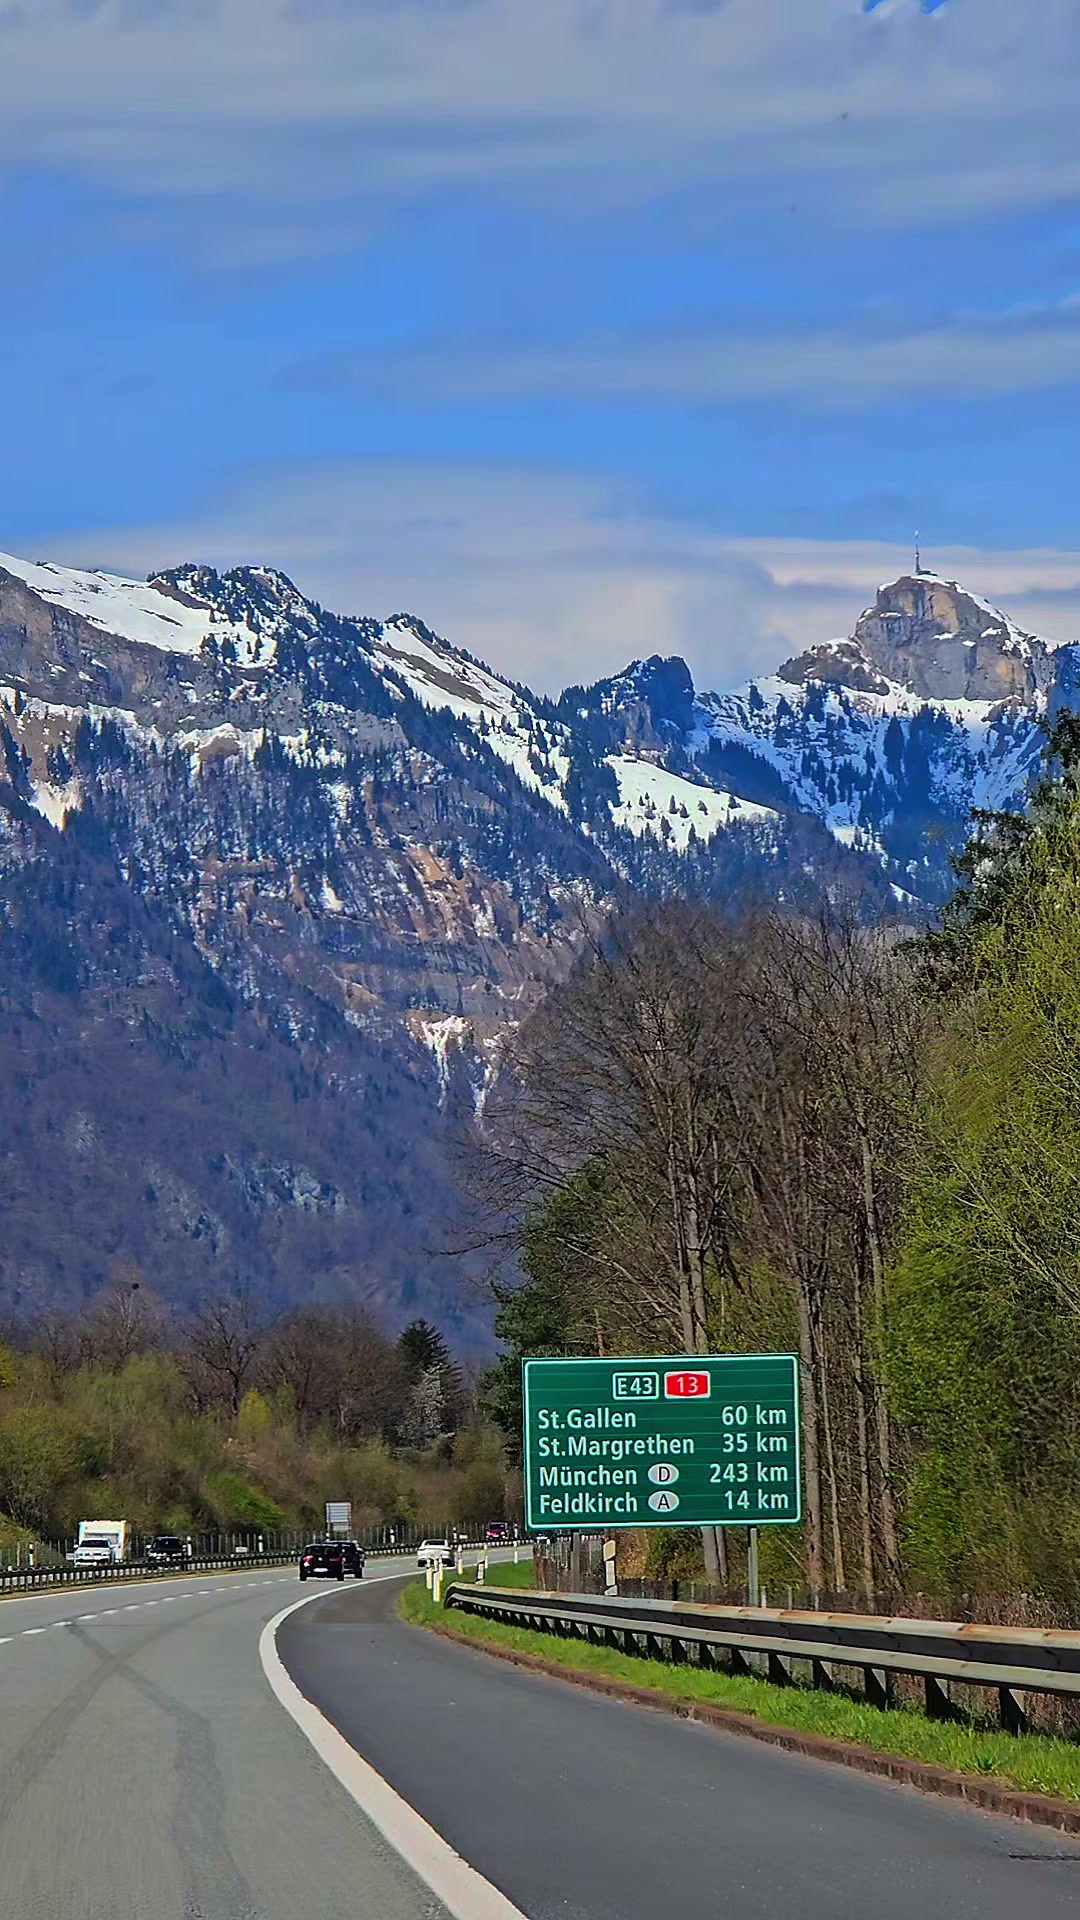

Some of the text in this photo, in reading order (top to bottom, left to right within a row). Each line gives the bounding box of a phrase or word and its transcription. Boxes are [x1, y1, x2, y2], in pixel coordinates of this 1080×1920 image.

[617, 1377, 652, 1395] E43
[677, 1377, 698, 1393] 13
[538, 1404, 787, 1429] St.Gallen 60 km
[538, 1432, 787, 1460] St.Margrethen 35 km
[539, 1462, 788, 1487] München D 243 km
[540, 1489, 789, 1513] Feldkirch A 14 km
